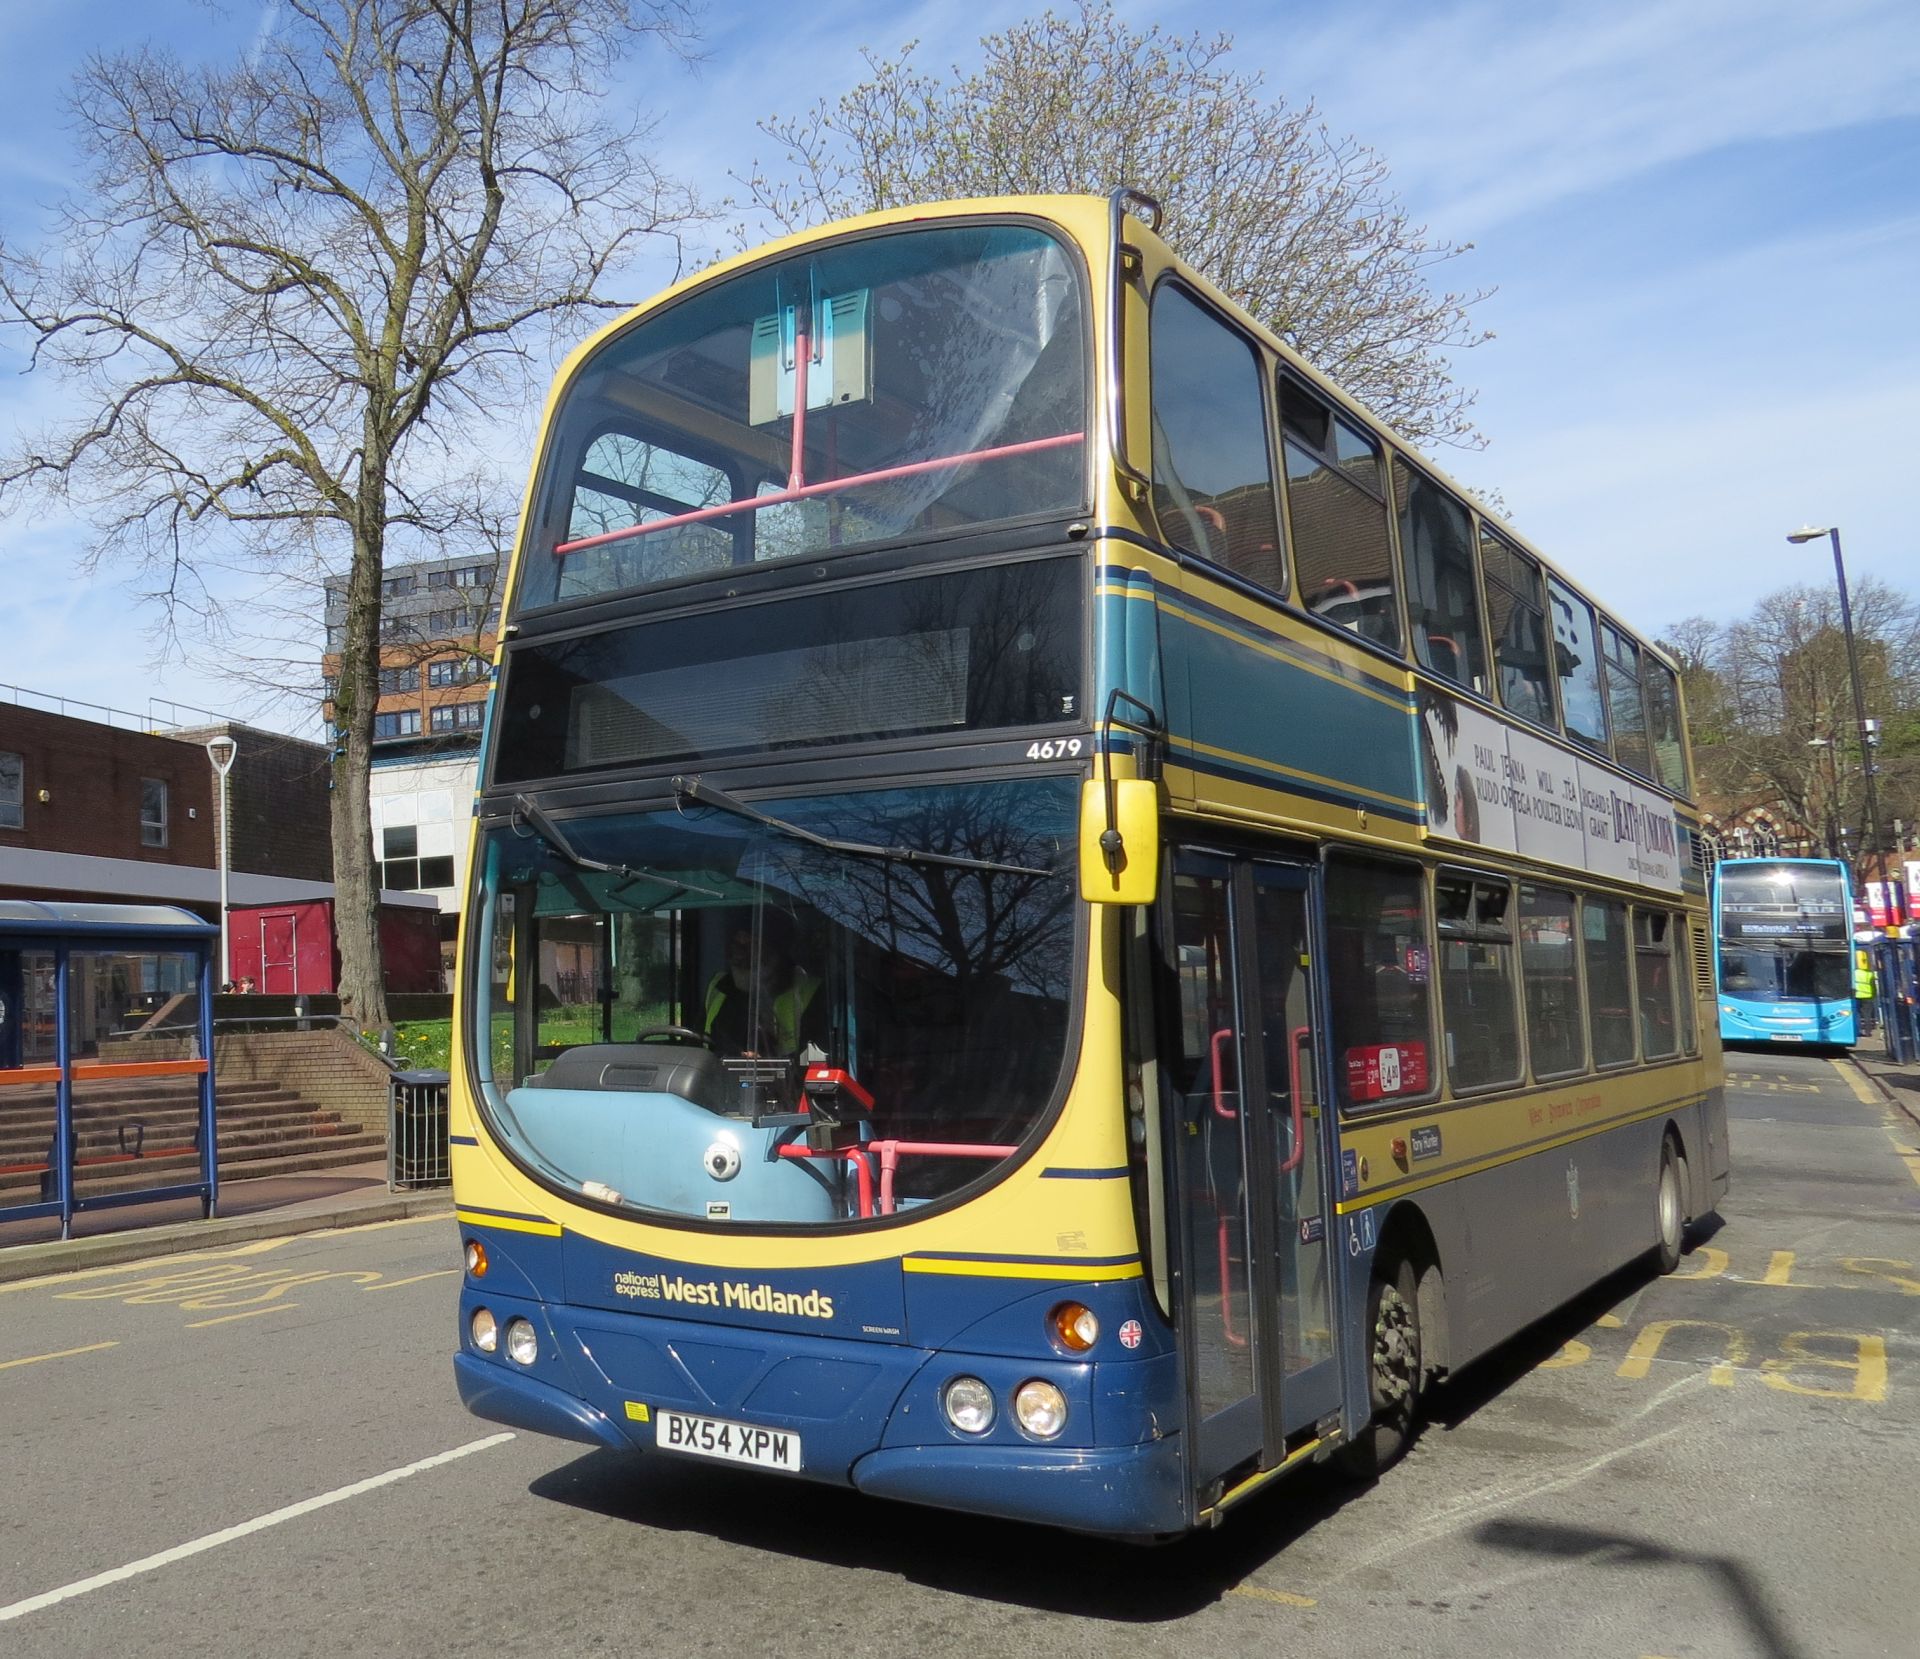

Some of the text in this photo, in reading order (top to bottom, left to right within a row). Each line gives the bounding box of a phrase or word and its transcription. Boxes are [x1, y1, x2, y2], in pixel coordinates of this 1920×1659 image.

[1027, 739, 1081, 759] 4679
[1474, 744, 1495, 773] PAUL
[1536, 769, 1553, 794] WILL
[1476, 777, 1498, 804] RUDD
[1533, 797, 1562, 825] POULTER
[1590, 817, 1608, 840] GRANT
[1610, 790, 1640, 846] DEATH
[614, 1271, 659, 1287] national
[615, 1283, 660, 1299] express
[661, 1275, 834, 1319] West Midlands
[862, 1325, 900, 1336] SCREEN WASH
[669, 1416, 788, 1464] BX54 XPM
